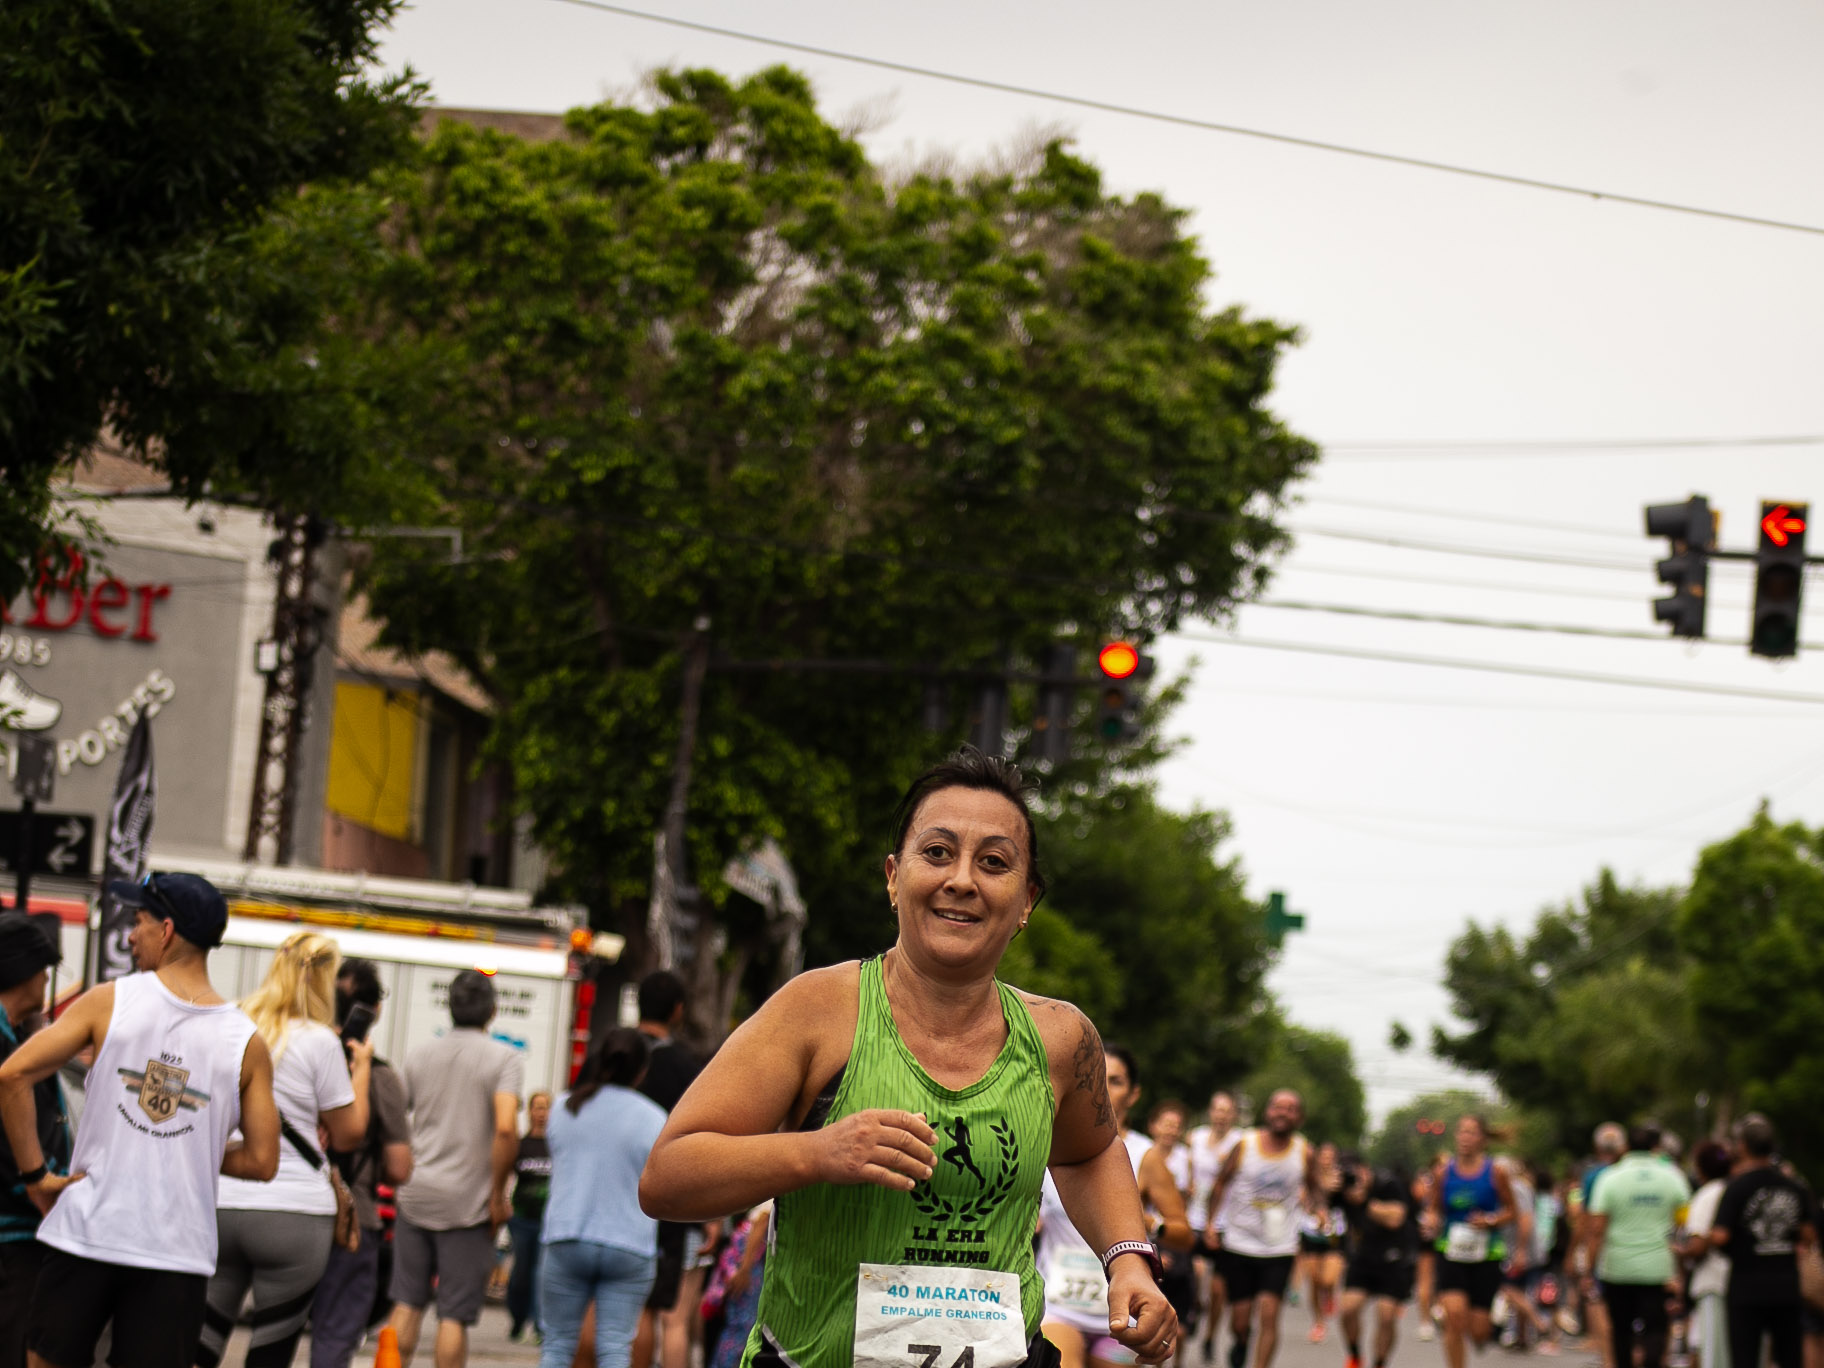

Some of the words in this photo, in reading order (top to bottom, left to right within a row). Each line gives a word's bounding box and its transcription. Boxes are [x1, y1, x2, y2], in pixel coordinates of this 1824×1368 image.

[0, 543, 172, 643] Ber
[148, 1095, 171, 1115] 40
[912, 1226, 939, 1241] LA
[946, 1229, 986, 1243] ERA
[904, 1247, 990, 1264] RUNNING
[887, 1284, 909, 1298] 40
[916, 1286, 1001, 1304] MARATON
[881, 1306, 942, 1318] EMPALME
[946, 1309, 1007, 1321] GRANEROS
